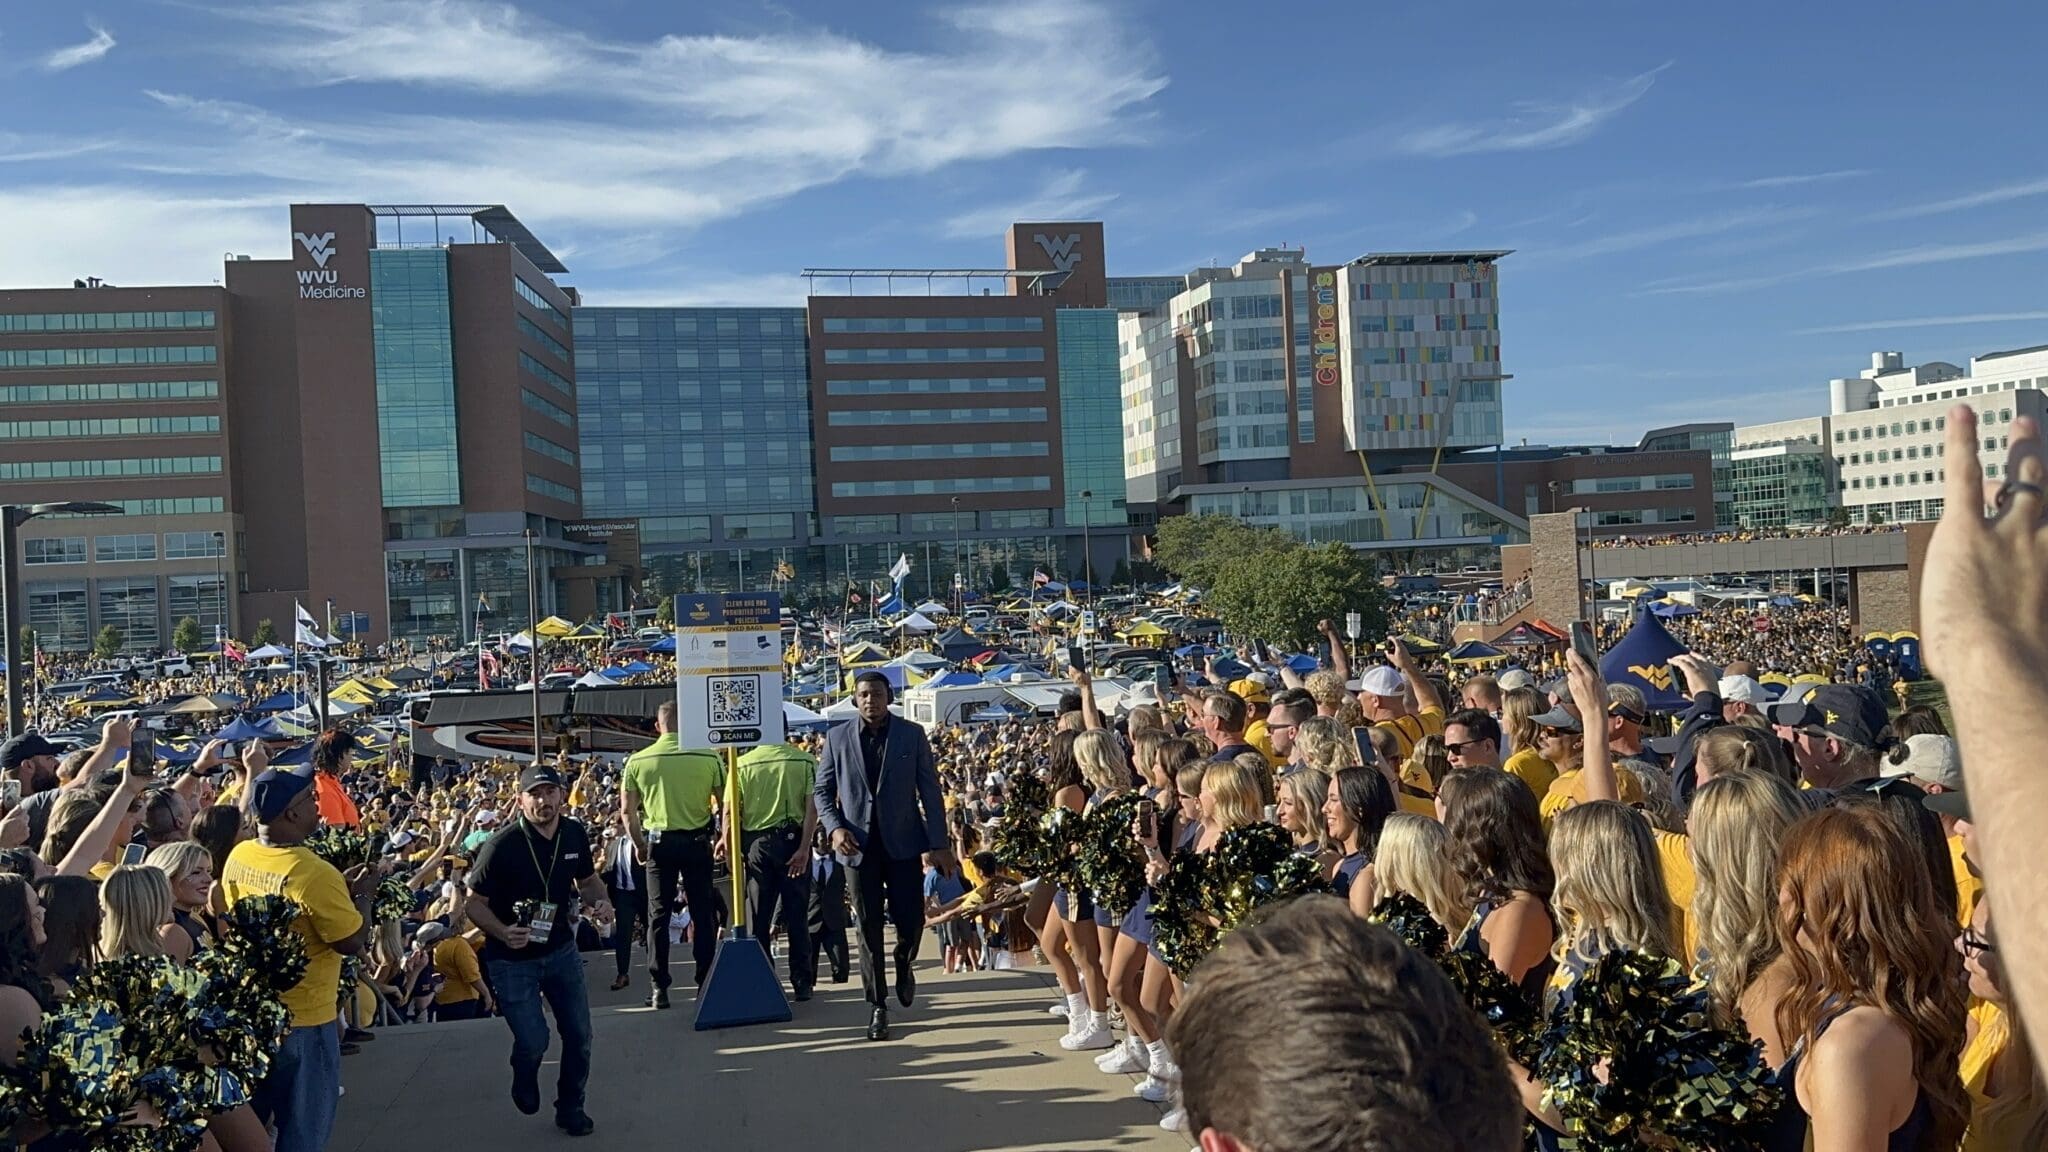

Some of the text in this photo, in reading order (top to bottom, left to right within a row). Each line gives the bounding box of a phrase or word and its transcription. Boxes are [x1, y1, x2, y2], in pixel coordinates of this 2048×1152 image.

[296, 270, 338, 284] WVU
[300, 285, 365, 299] Medicine
[1312, 271, 1338, 386] Children's
[723, 731, 755, 741] SCAN ME
